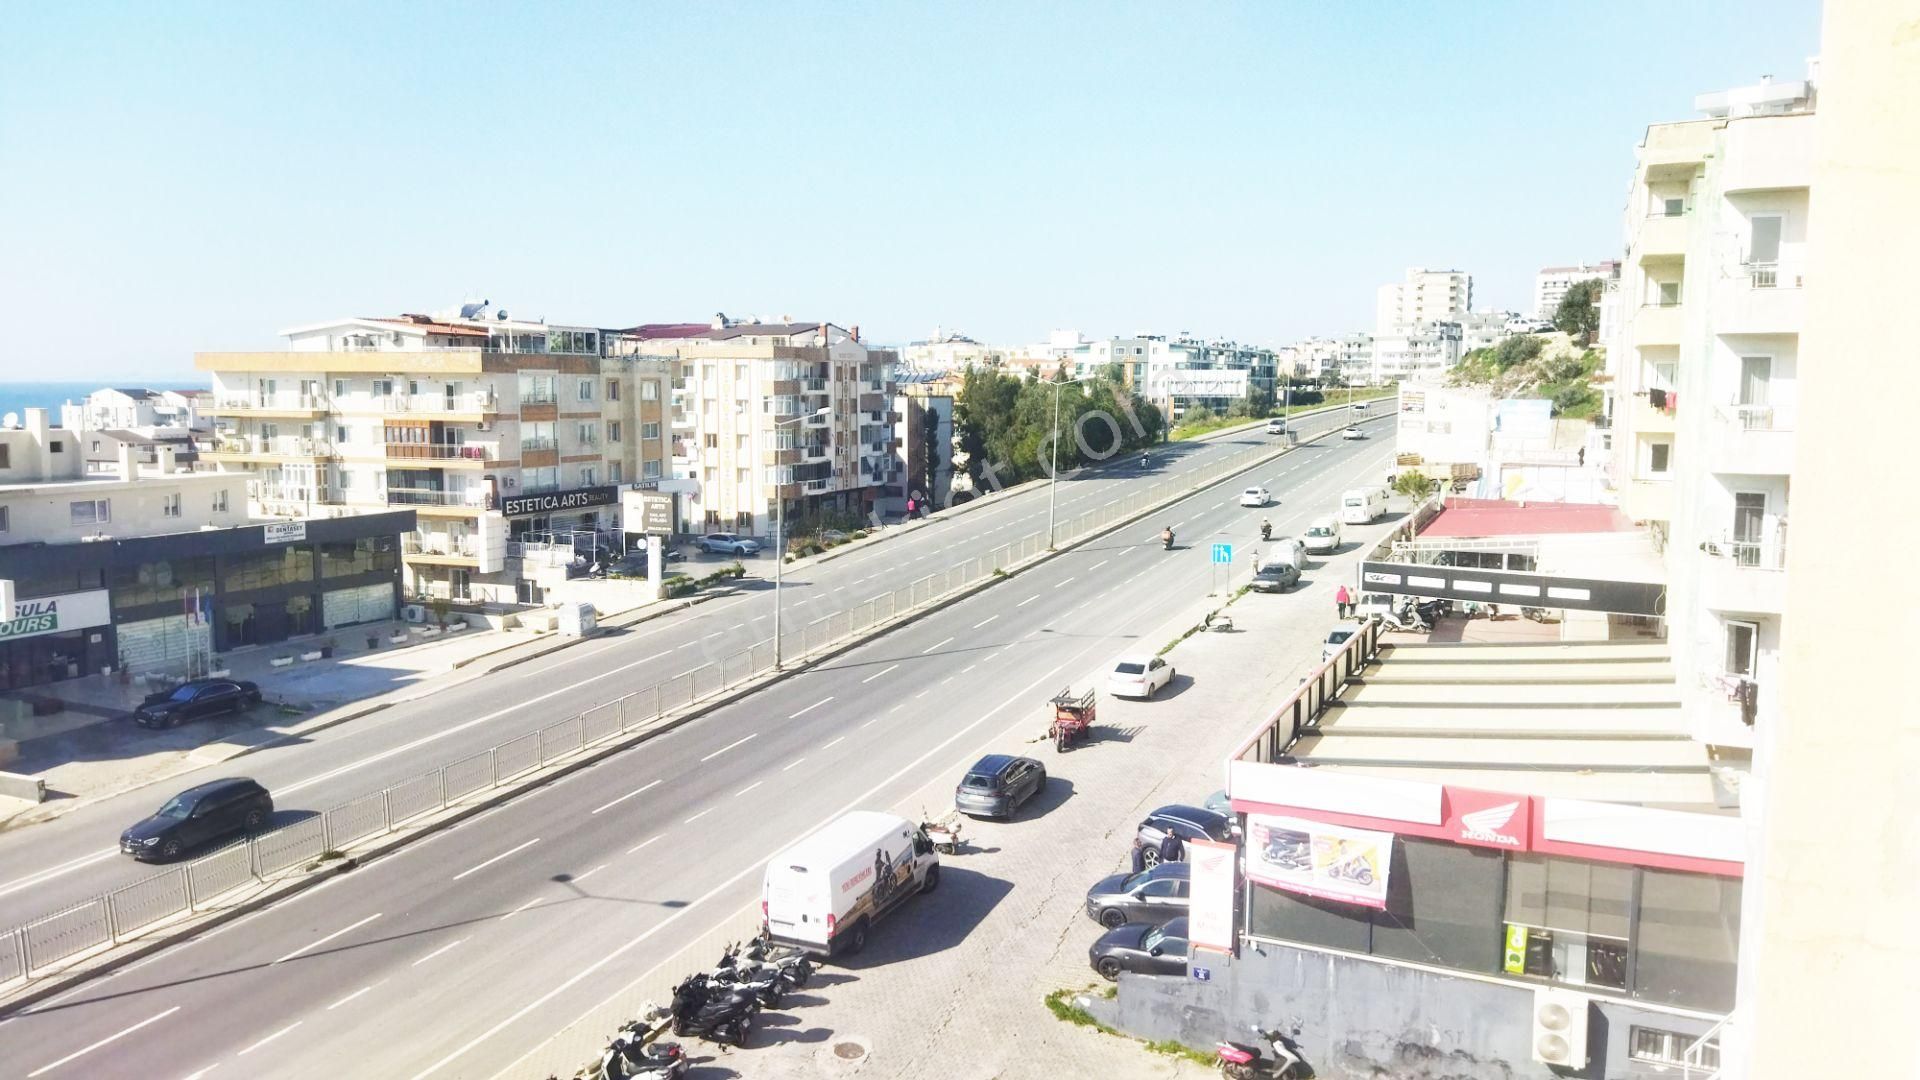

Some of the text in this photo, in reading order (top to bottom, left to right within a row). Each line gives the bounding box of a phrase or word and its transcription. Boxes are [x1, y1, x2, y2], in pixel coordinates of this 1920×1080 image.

[506, 497, 559, 514] ESTETICA
[561, 493, 588, 508] ARTS
[1461, 830, 1520, 846] HONDA
